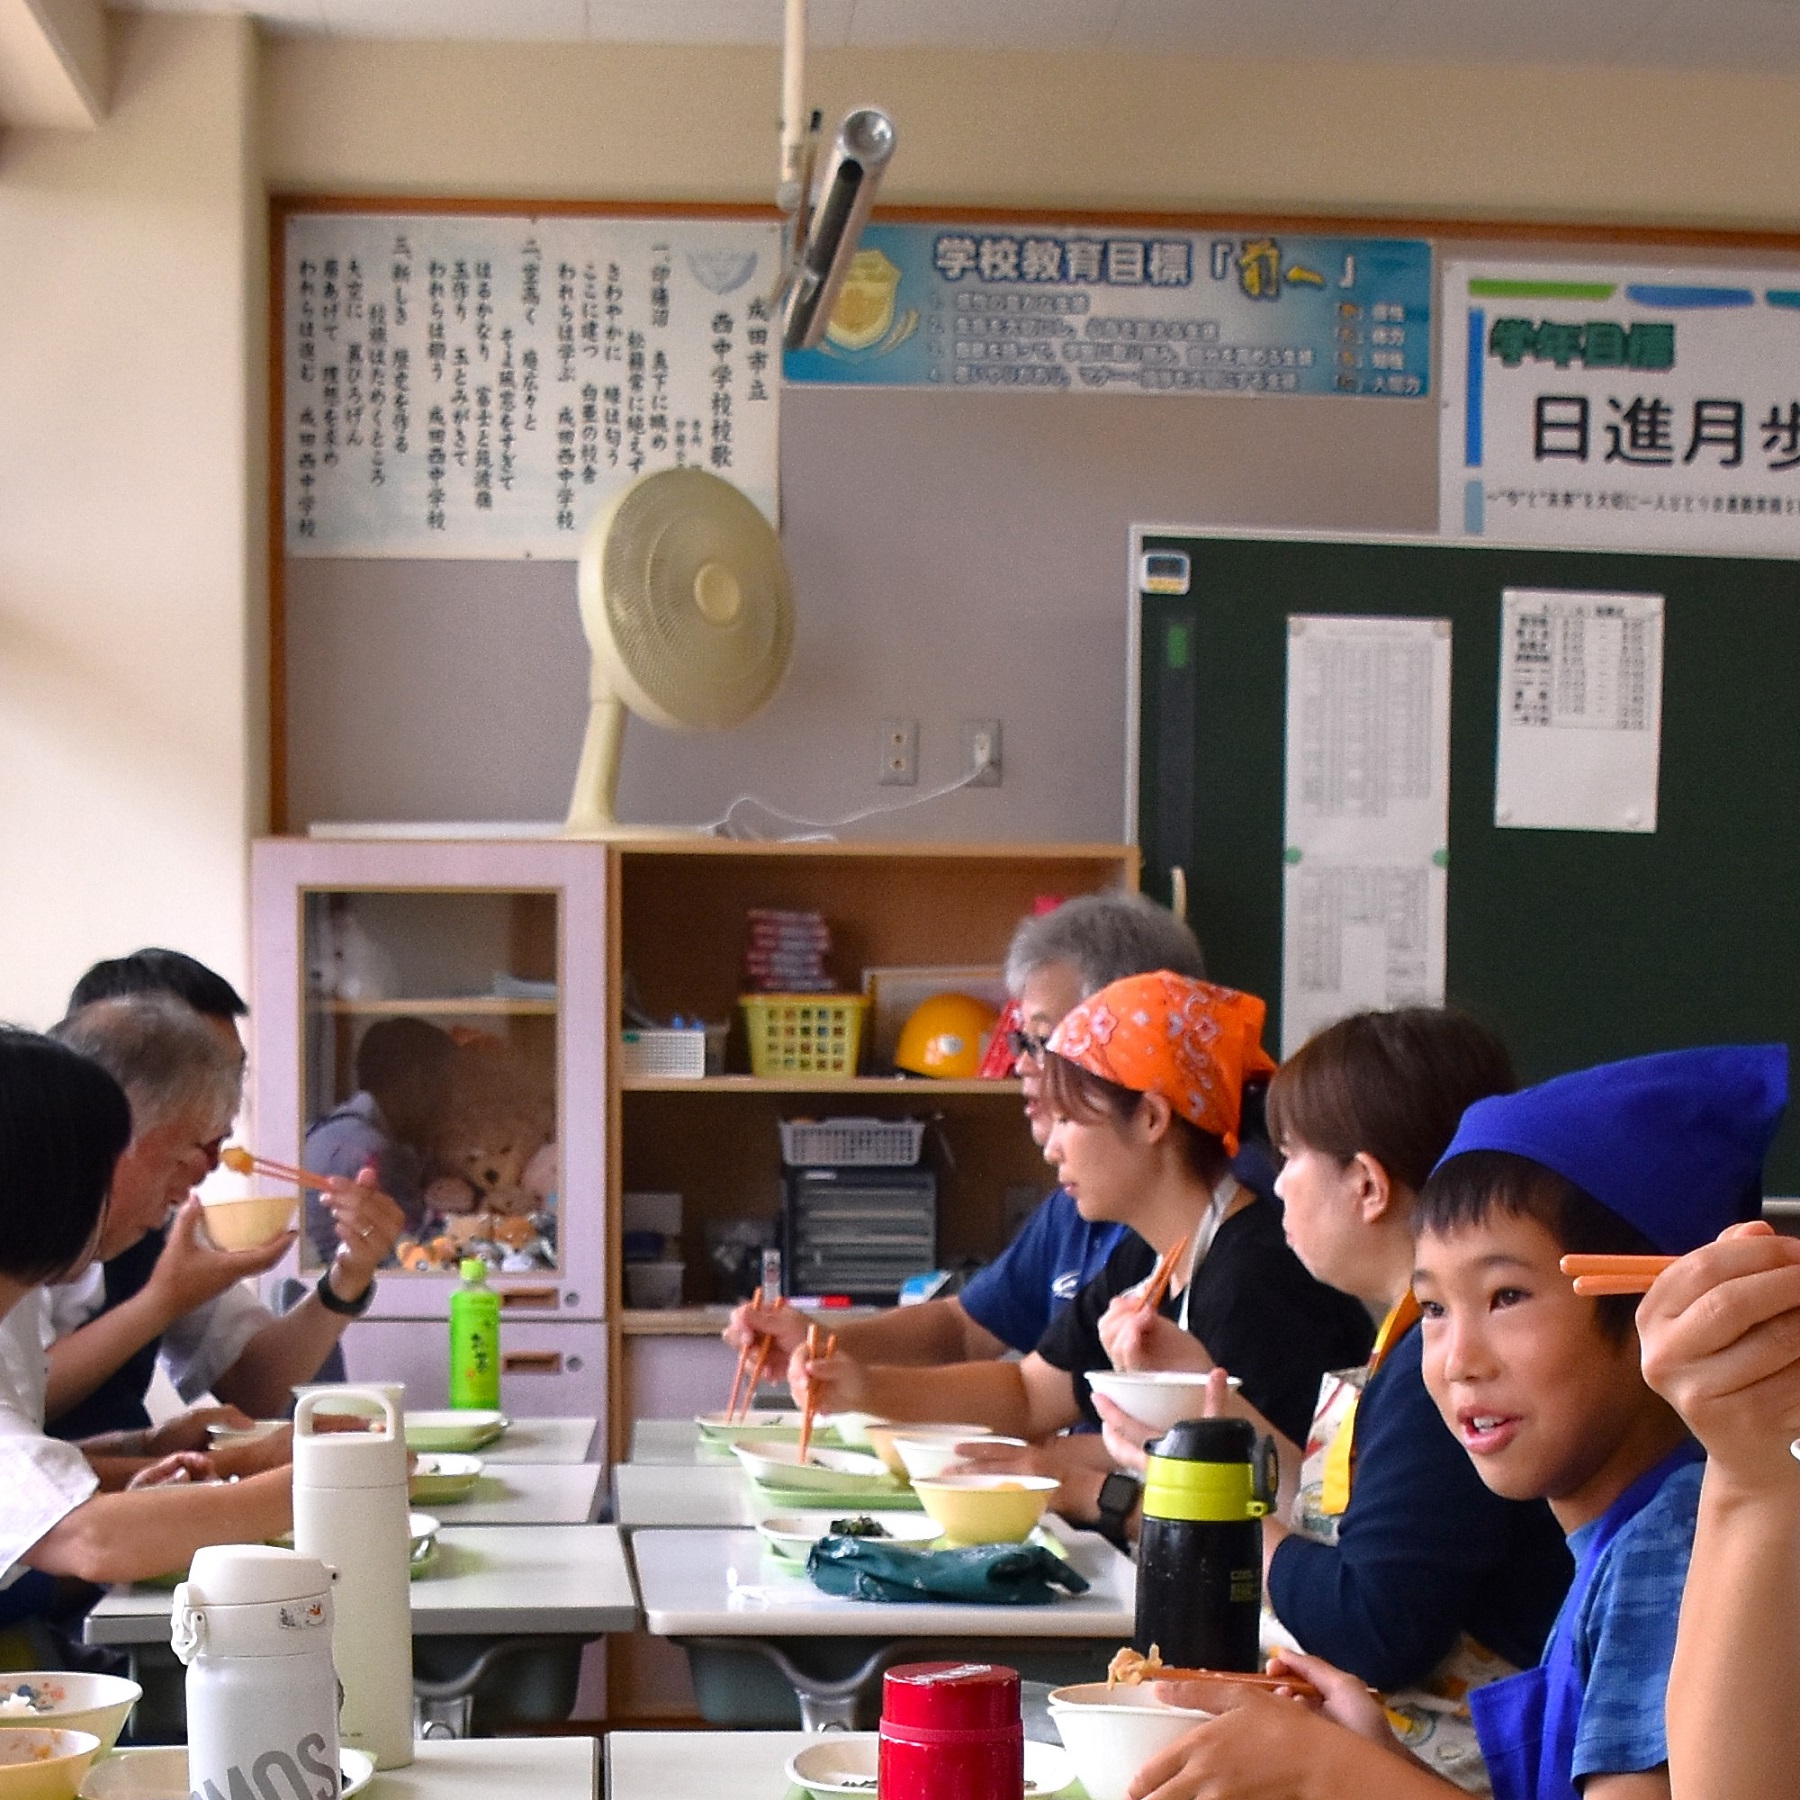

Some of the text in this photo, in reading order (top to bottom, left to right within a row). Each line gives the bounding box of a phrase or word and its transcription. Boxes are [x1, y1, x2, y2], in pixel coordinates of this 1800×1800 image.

[604, 263, 622, 362] さわやかに
[933, 234, 1193, 287] 学校教育目標
[712, 313, 732, 466] 西中学校校歌
[748, 297, 768, 401] 成田市立
[299, 407, 317, 537] 成田西中学校
[427, 406, 445, 531] 成田西中学校
[557, 407, 575, 530] 成田西中学校
